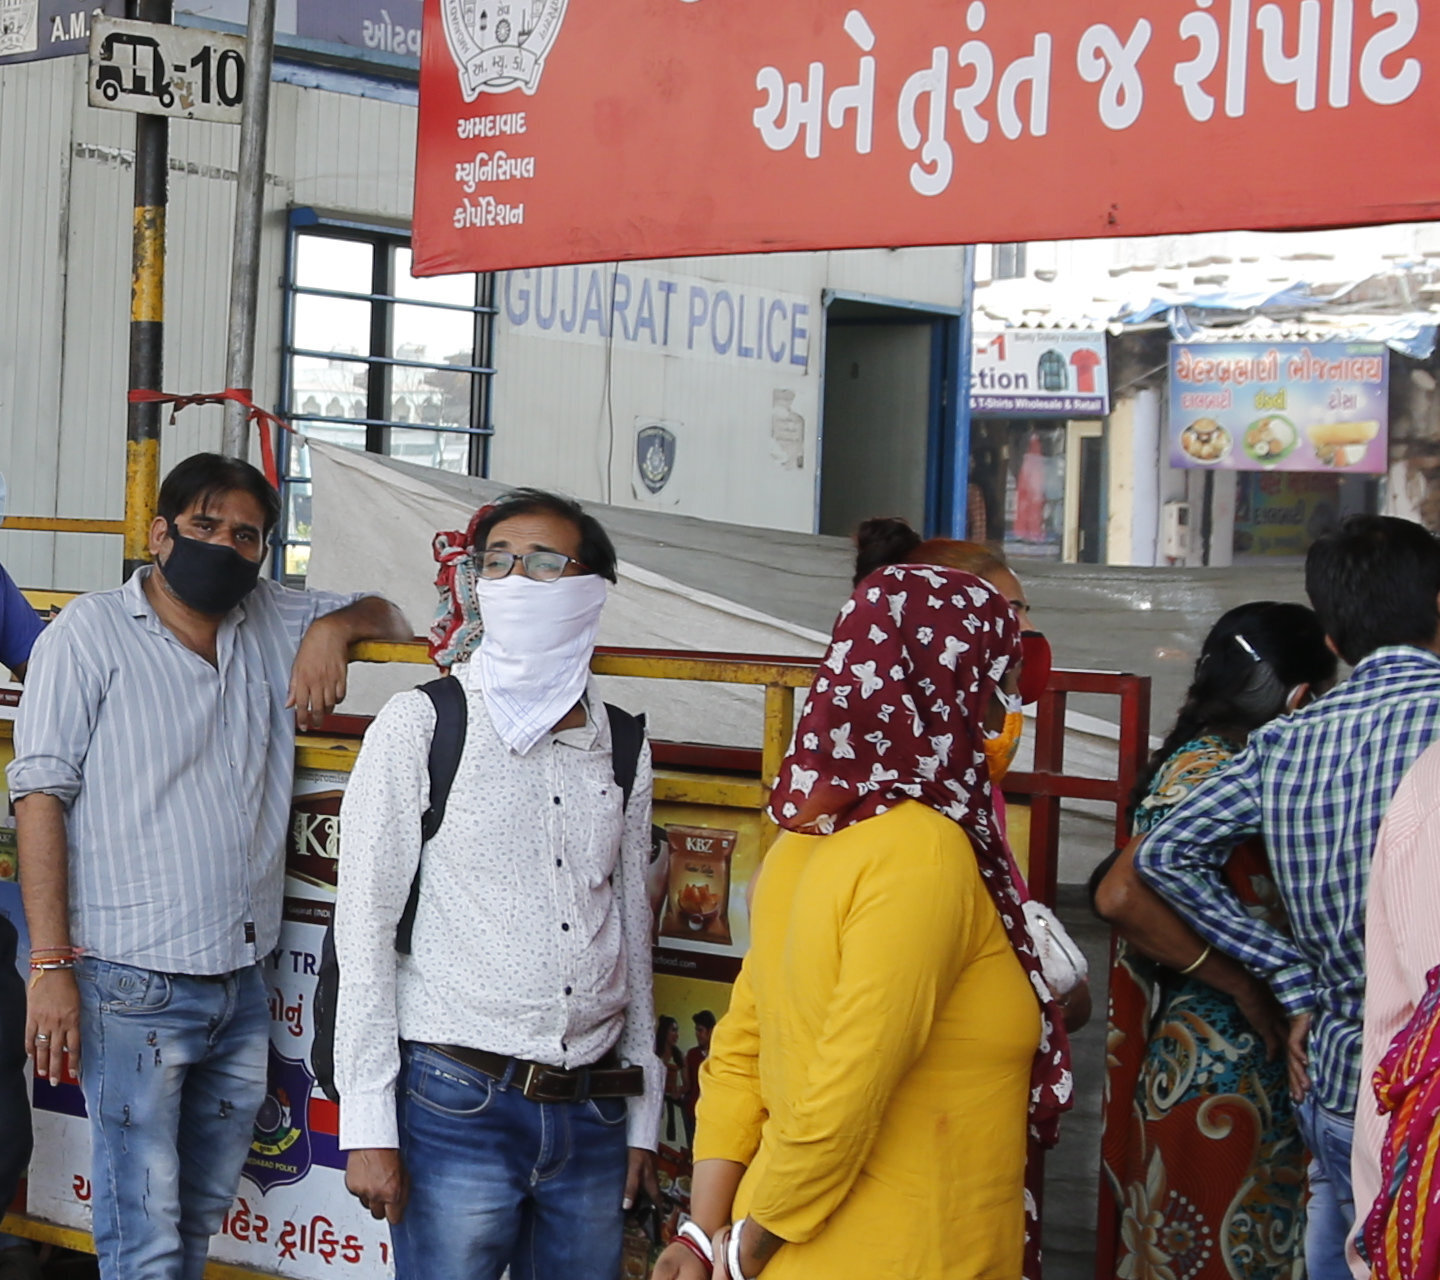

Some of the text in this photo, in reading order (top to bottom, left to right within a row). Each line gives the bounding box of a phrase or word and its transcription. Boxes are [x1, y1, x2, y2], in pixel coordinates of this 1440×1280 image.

[753, 10, 876, 159] અને
[897, 0, 1052, 196] તુરંત
[1076, 18, 1152, 130] જ
[456, 111, 527, 139] અમદાવાદ
[455, 150, 535, 193] મ્યુનિસિપલ
[504, 267, 810, 367] GUJARAT POLICE
[1287, 348, 1383, 383] ભોજનાલય
[976, 397, 1013, 410] T-Shirts
[1014, 398, 1062, 410] Wholesale
[1073, 398, 1101, 410] Retail
[686, 836, 714, 853] KBZ
[275, 1160, 298, 1174] POLICE
[277, 1215, 364, 1265] ટ્રાફિક
